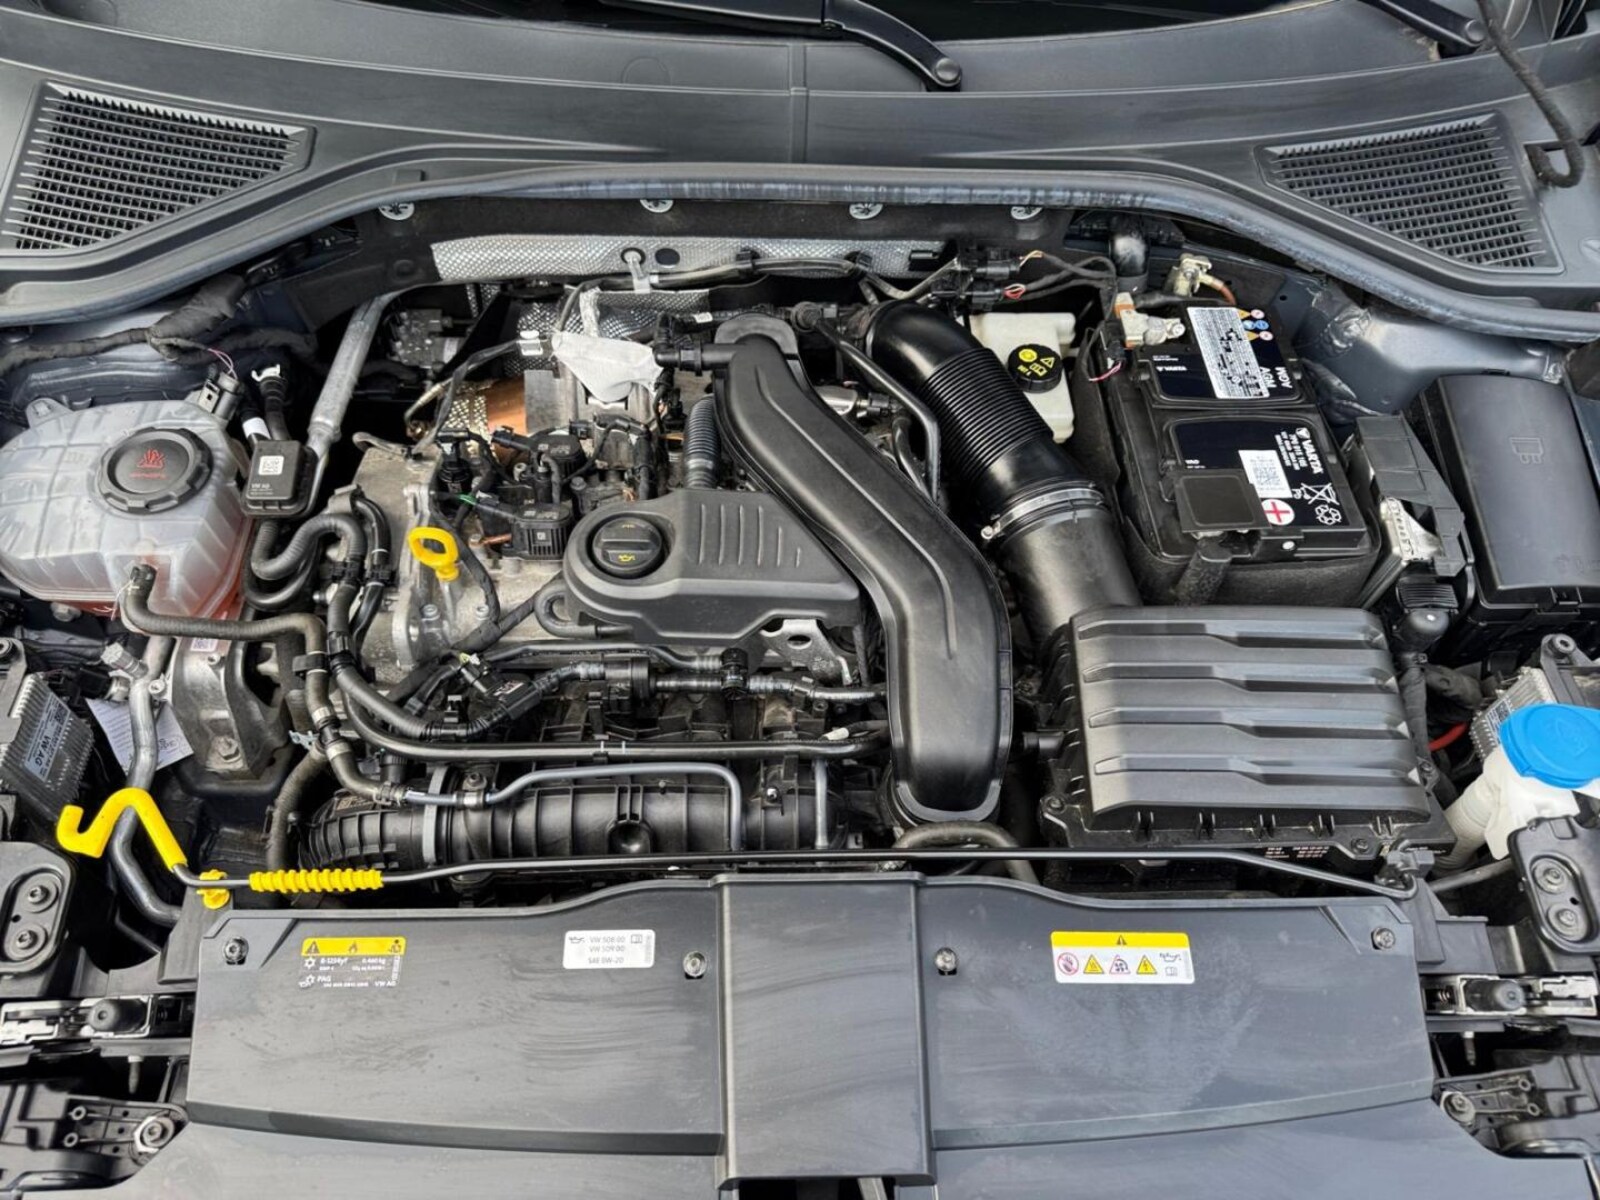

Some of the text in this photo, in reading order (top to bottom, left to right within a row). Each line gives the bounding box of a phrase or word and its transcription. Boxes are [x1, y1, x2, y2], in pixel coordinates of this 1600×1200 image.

[1302, 439, 1324, 474] VARTA
[35, 735, 52, 767] VW AG
